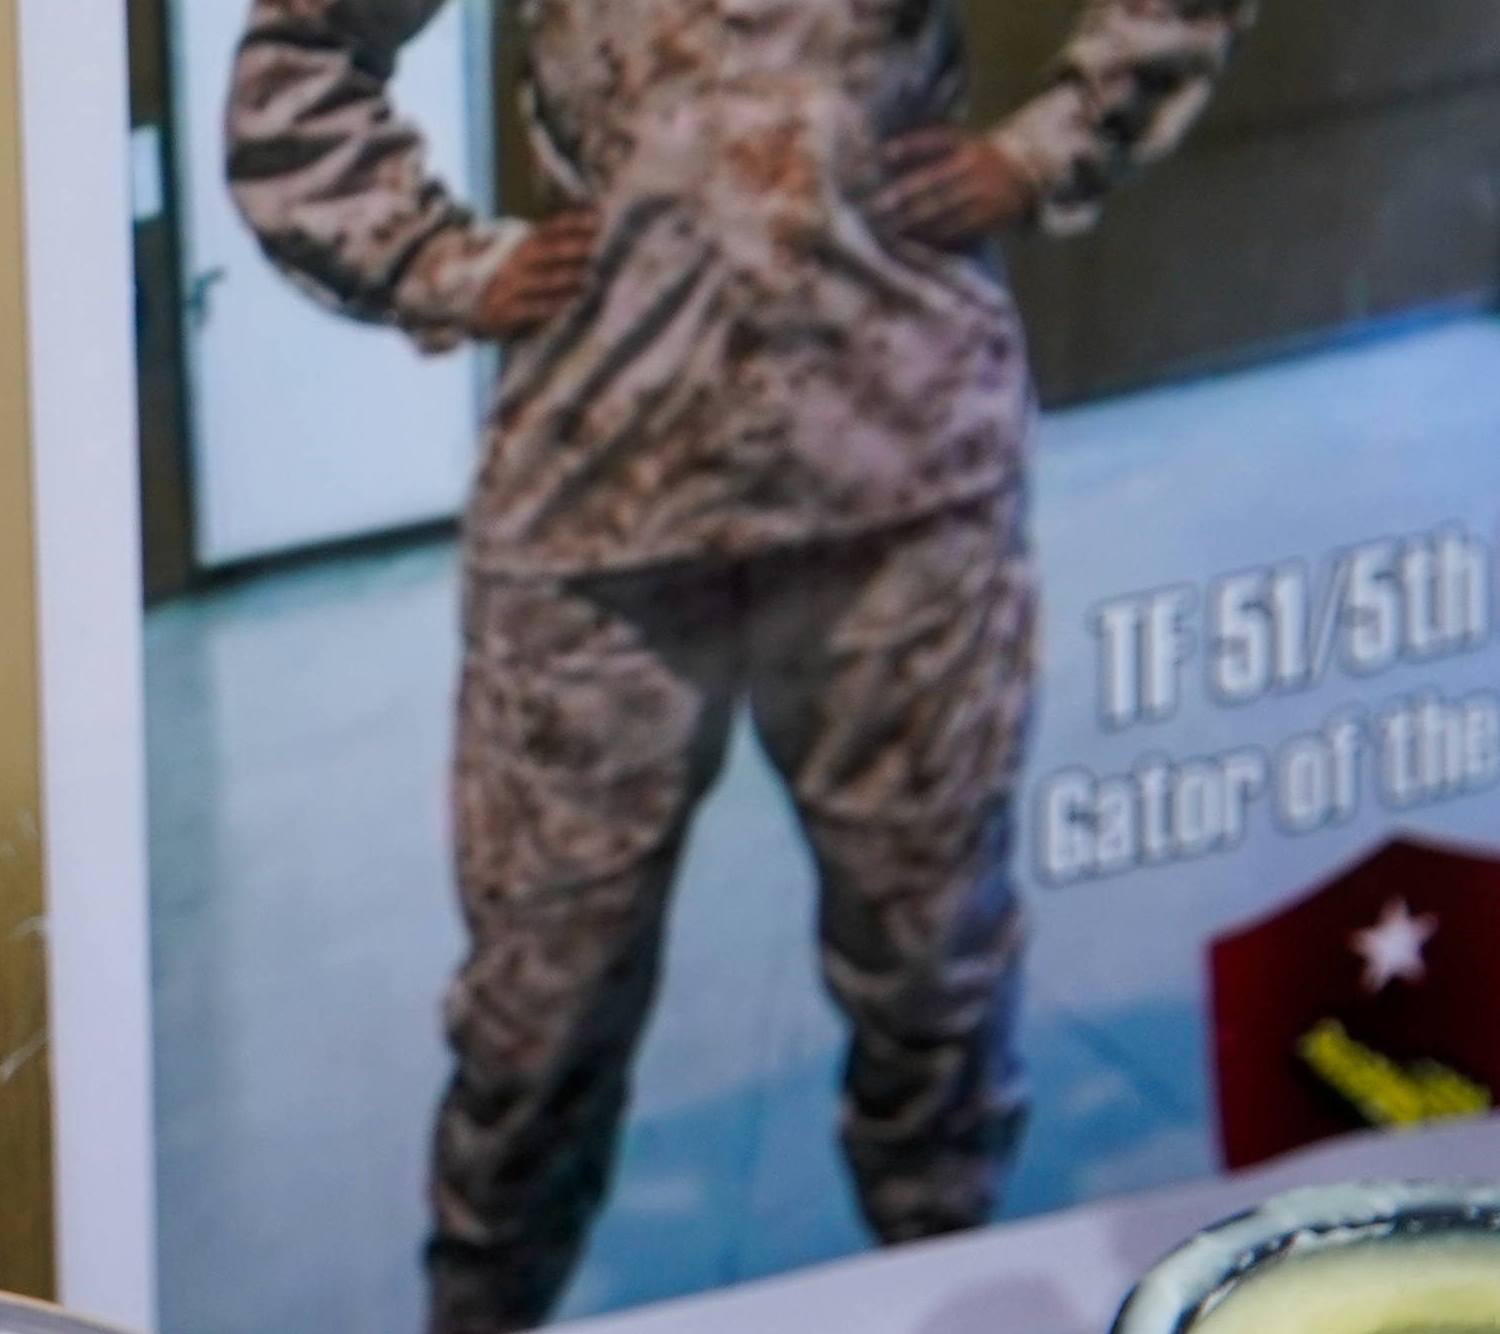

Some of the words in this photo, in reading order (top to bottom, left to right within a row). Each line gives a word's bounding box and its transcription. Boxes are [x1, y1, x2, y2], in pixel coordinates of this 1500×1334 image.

[1090, 587, 1198, 725] TF
[1208, 529, 1488, 701] 51/5th
[1042, 754, 1265, 875] Gator
[1280, 717, 1362, 831] of
[1382, 701, 1500, 802] the
